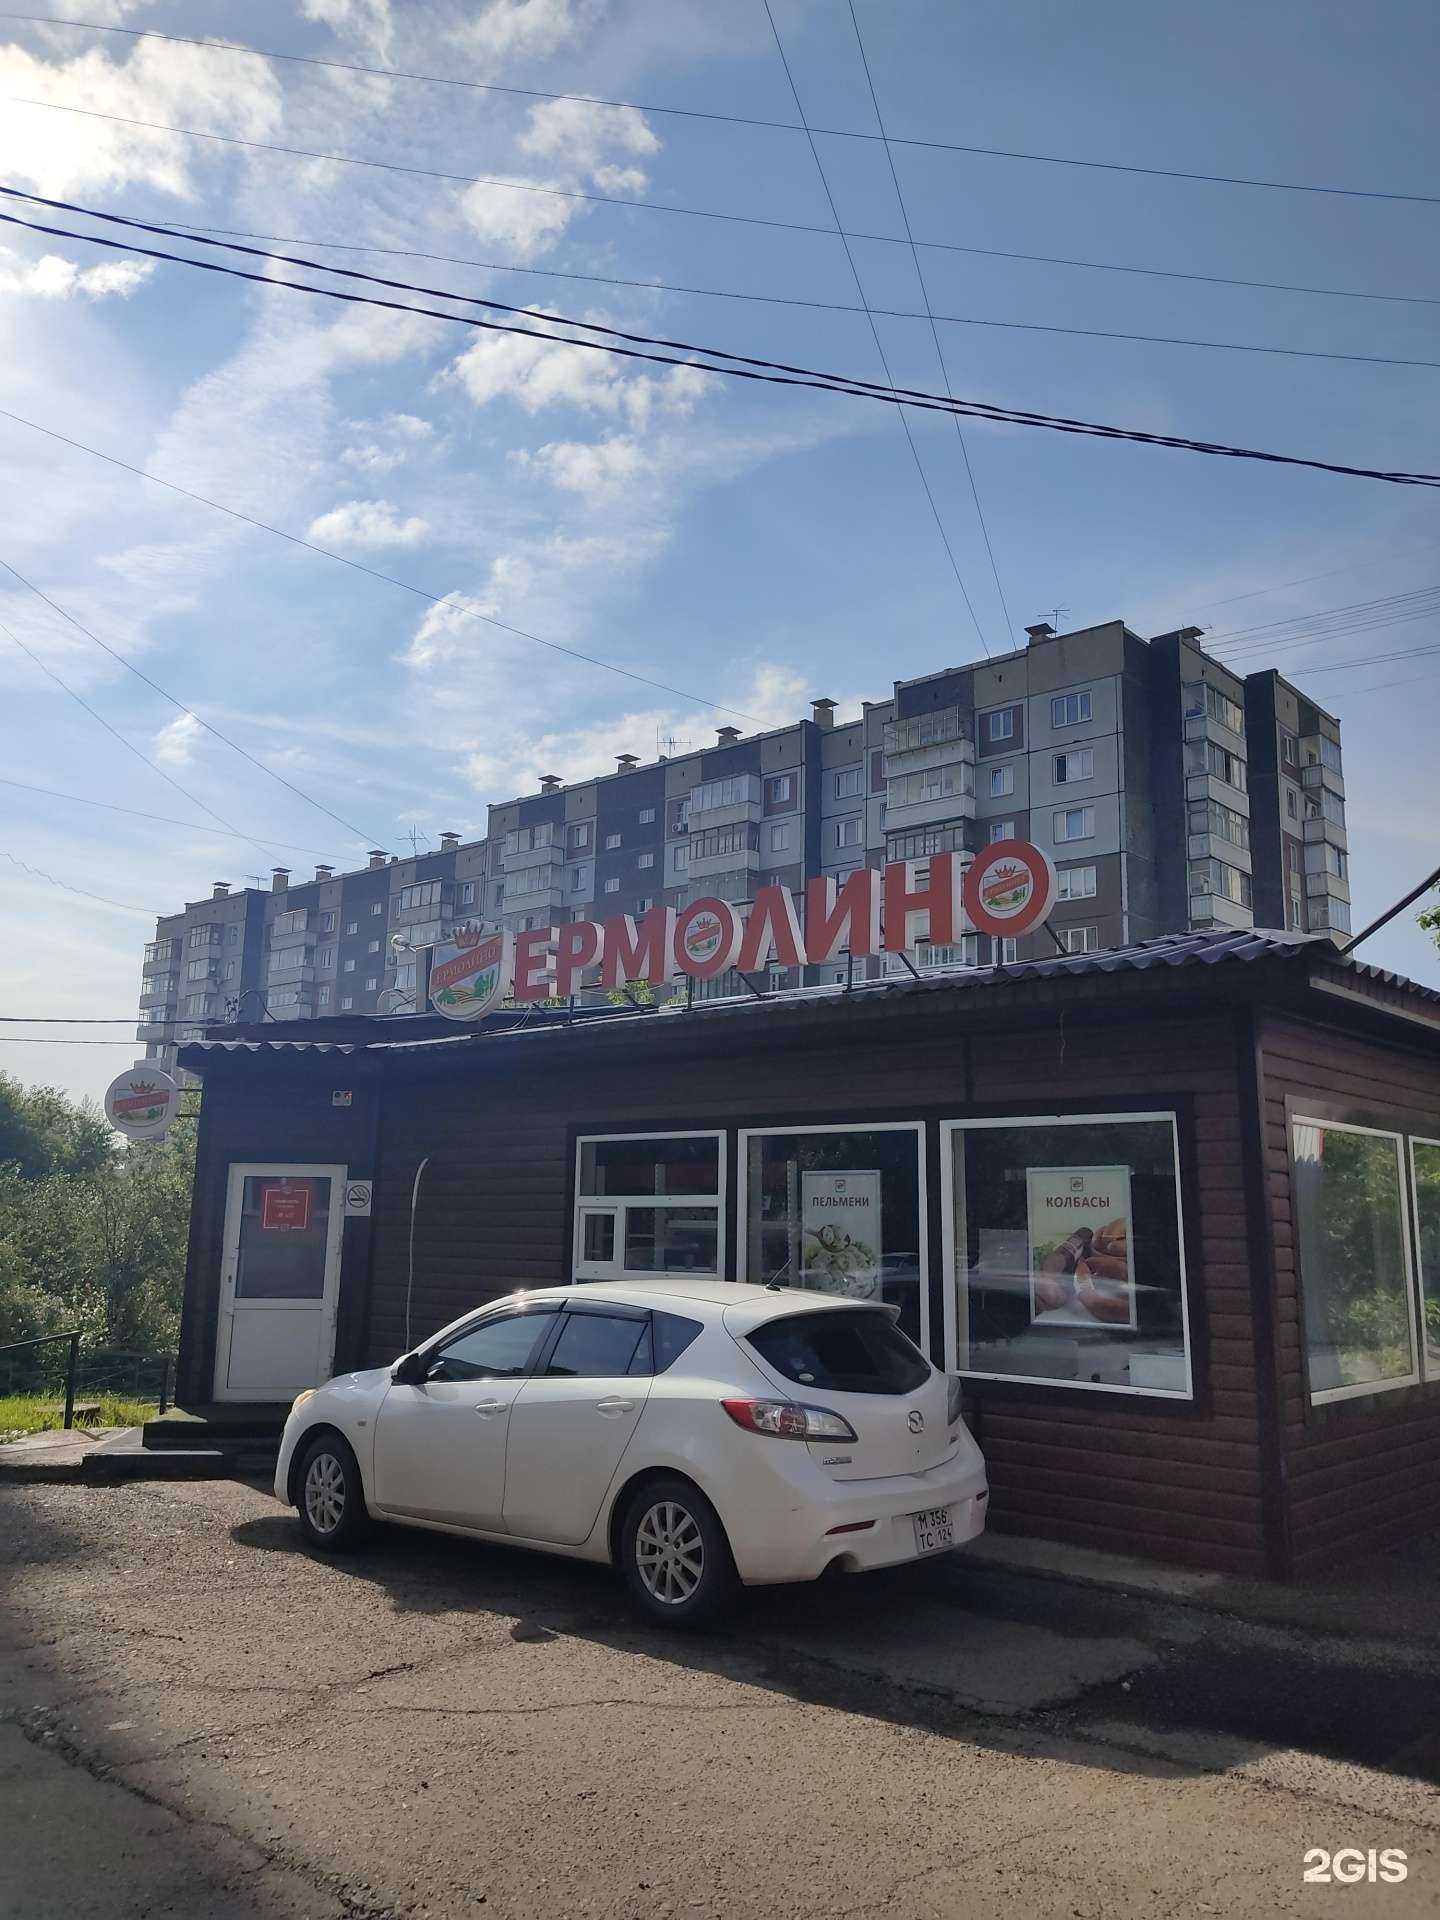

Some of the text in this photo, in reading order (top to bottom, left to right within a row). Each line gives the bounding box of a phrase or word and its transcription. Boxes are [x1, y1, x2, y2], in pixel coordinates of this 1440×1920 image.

[515, 839, 1054, 1002] ЕРМОЛИНО
[812, 1196, 869, 1207] ПЕЛЬМЕНИ
[1046, 1196, 1112, 1208] КОЛБАСЫ
[929, 1509, 947, 1527] 356
[937, 1528, 952, 1541] 124
